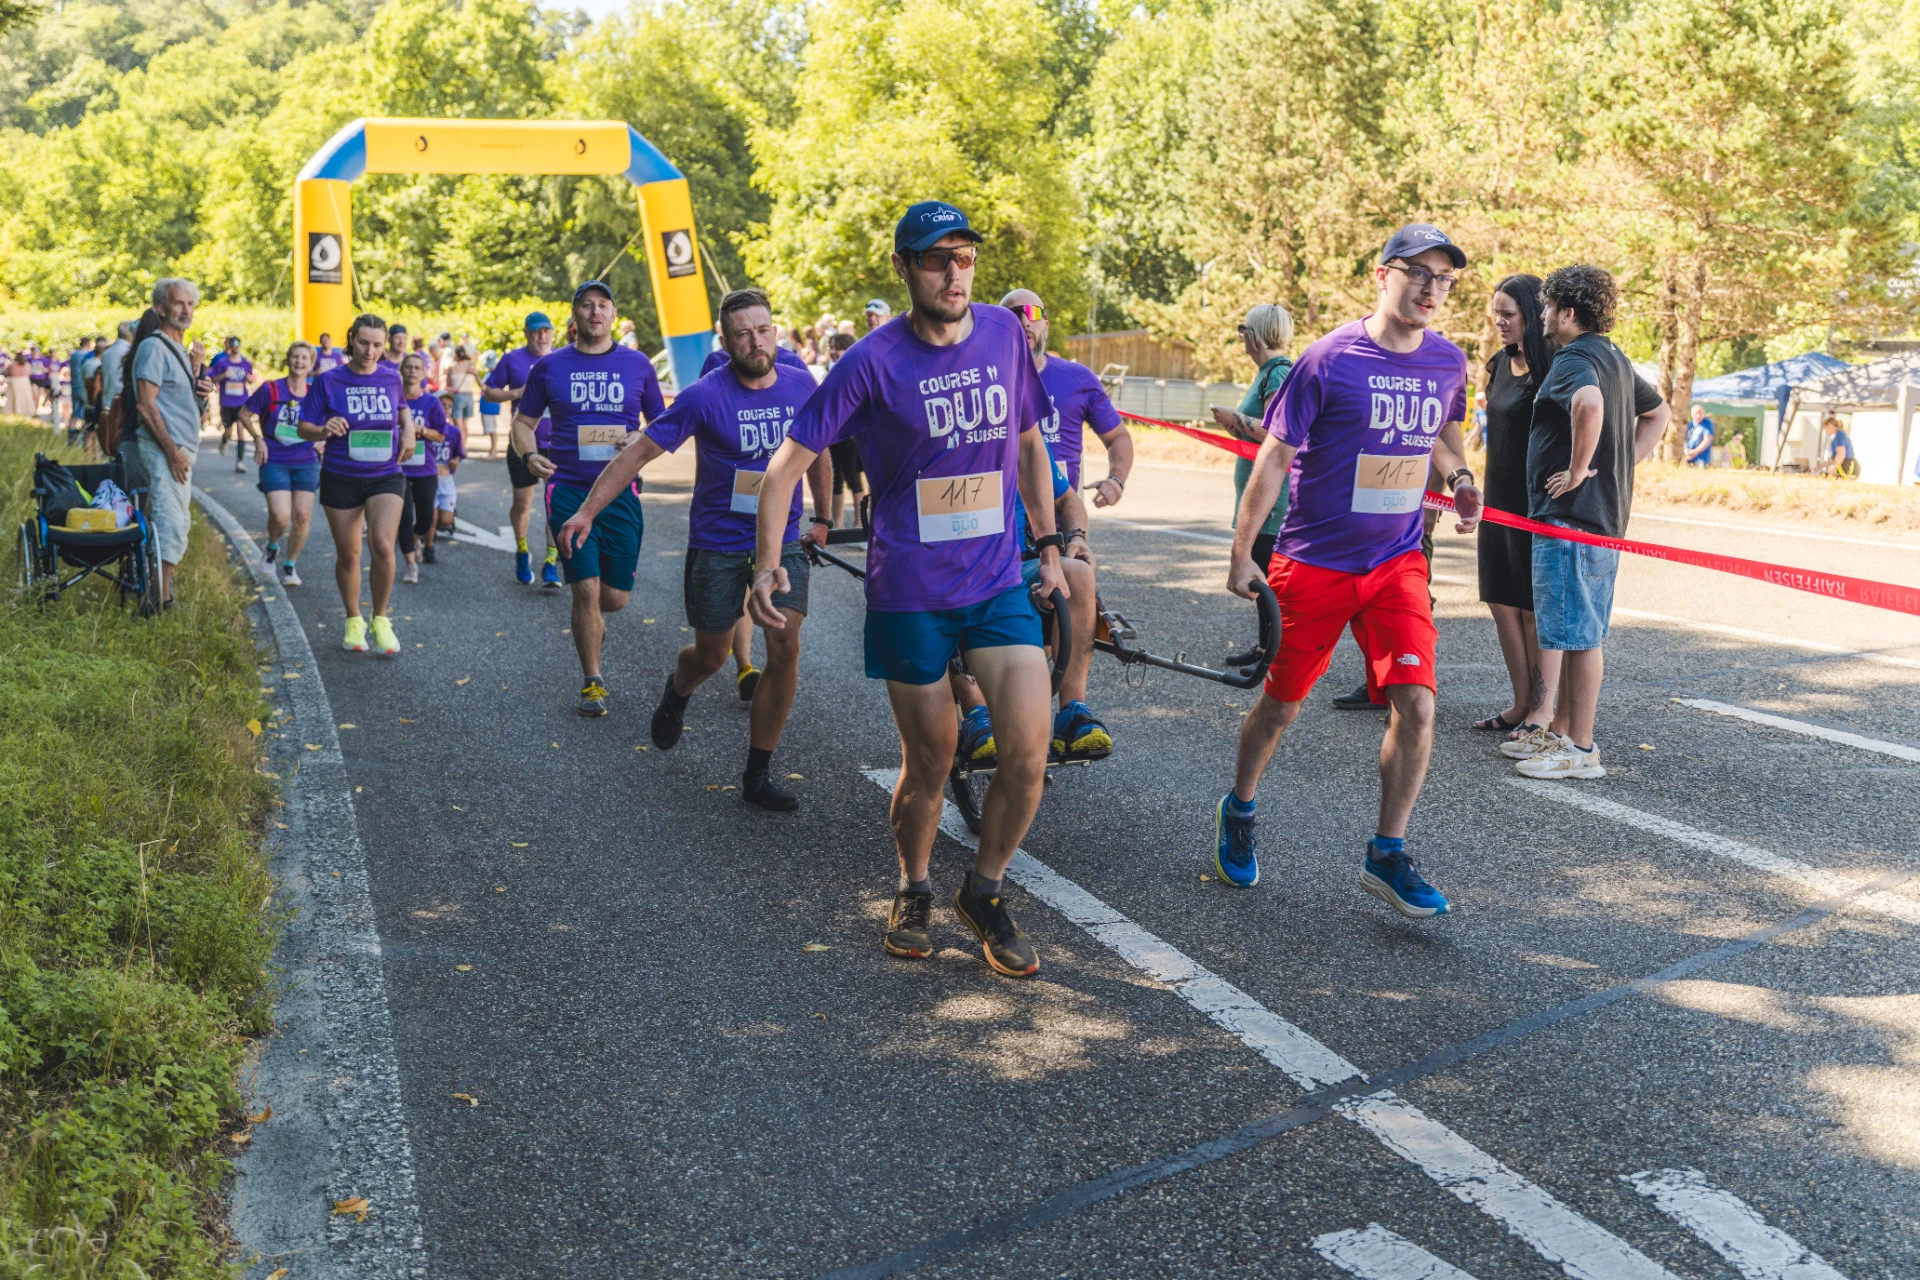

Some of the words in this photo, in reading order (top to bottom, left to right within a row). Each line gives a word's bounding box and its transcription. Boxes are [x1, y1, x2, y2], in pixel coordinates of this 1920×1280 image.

[570, 371, 608, 381] COURSE
[919, 368, 982, 395] COURSE
[1368, 376, 1422, 392] COURSE
[345, 387, 377, 395] COURSE
[571, 381, 625, 403] DUO
[347, 395, 392, 414] DUO
[595, 404, 624, 412] SUISSE
[925, 384, 1008, 438] DUO
[737, 407, 781, 421] COURSE
[1368, 392, 1443, 434] DUO
[362, 433, 380, 445] 26
[588, 429, 618, 443] 117
[965, 426, 1008, 444] SUISSE
[1043, 433, 1061, 443] SSE
[1376, 460, 1418, 485] 117
[940, 476, 984, 507] 117
[1383, 495, 1406, 506] DUO
[951, 518, 979, 531] DUO
[1764, 569, 1846, 597] RAIFFEISEN
